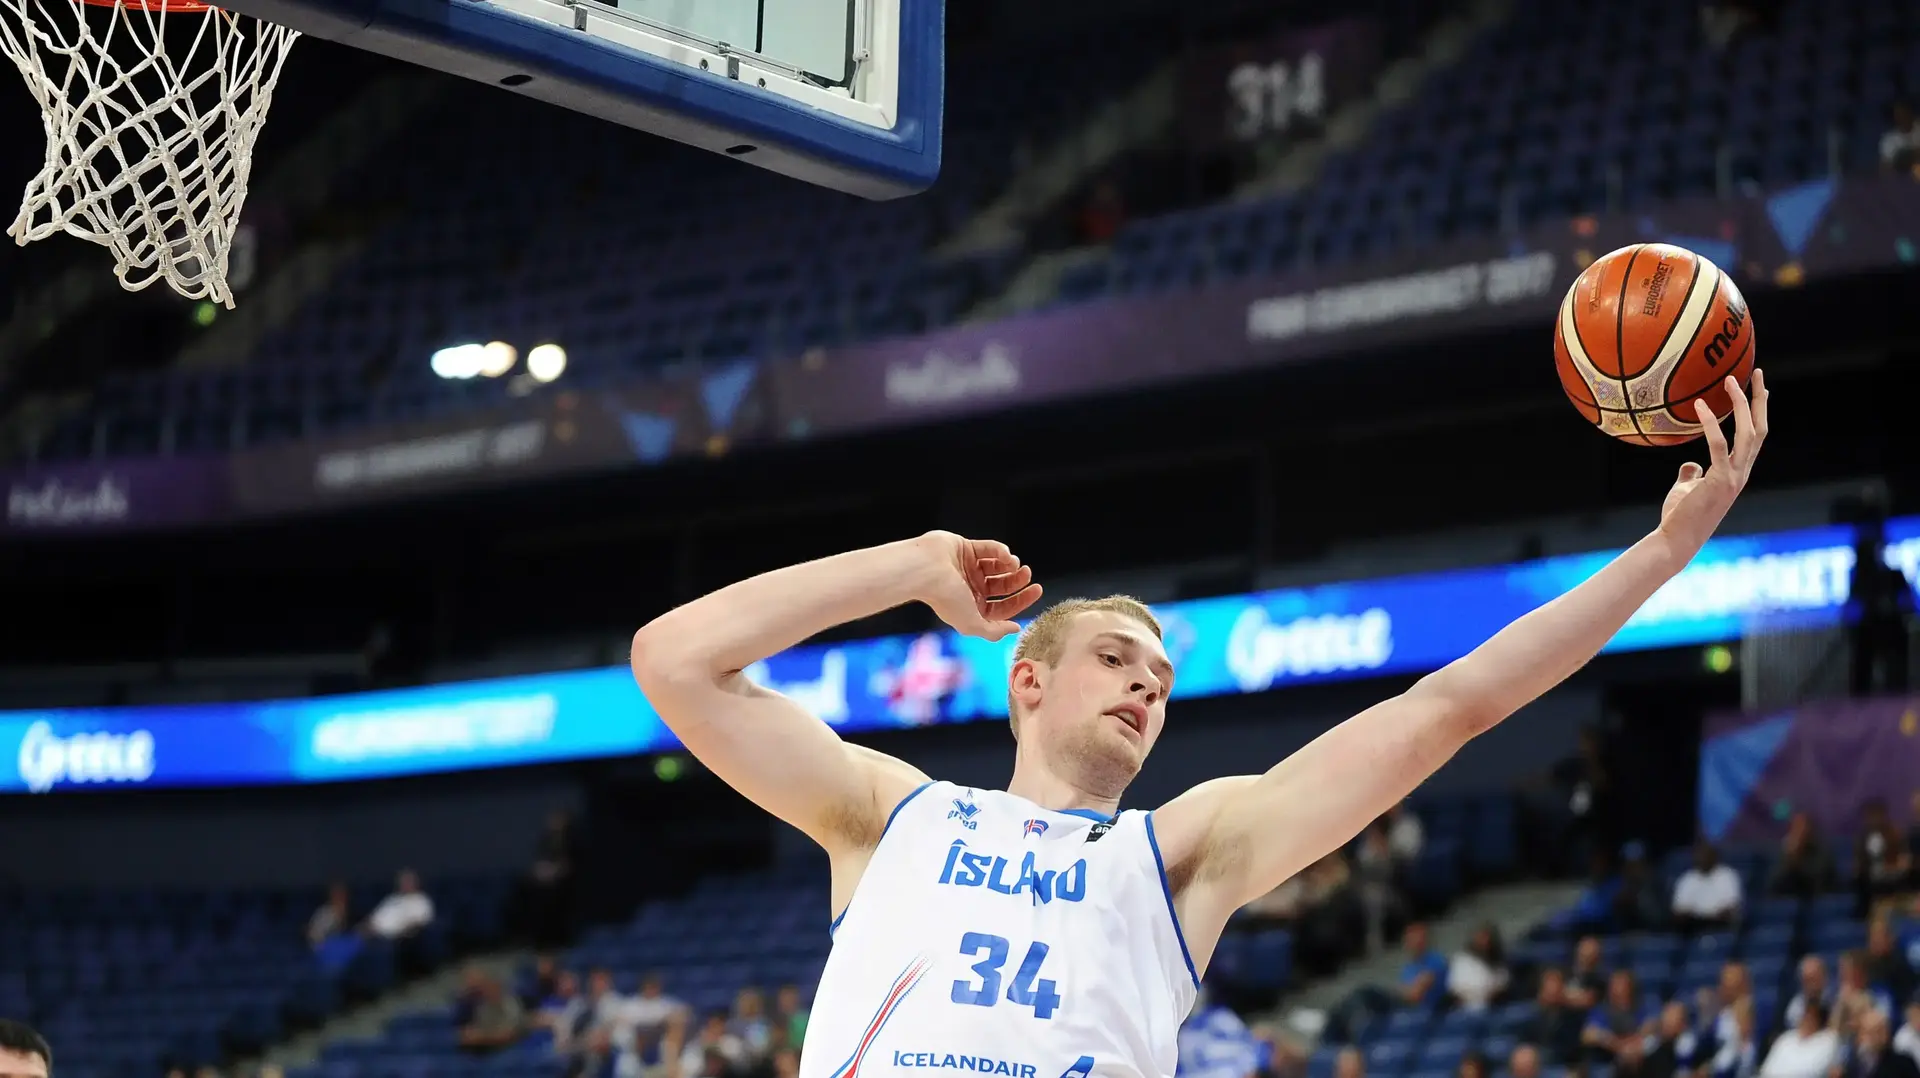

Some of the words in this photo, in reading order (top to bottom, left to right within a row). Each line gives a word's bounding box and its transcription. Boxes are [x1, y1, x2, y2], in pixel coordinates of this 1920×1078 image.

[1227, 56, 1323, 138] 314
[1642, 261, 1670, 316] EUROBASKET
[1226, 605, 1393, 692] Greece
[18, 720, 155, 793] Greece
[951, 932, 1060, 1019] 34
[893, 1050, 1037, 1078] ICELANDAIR
